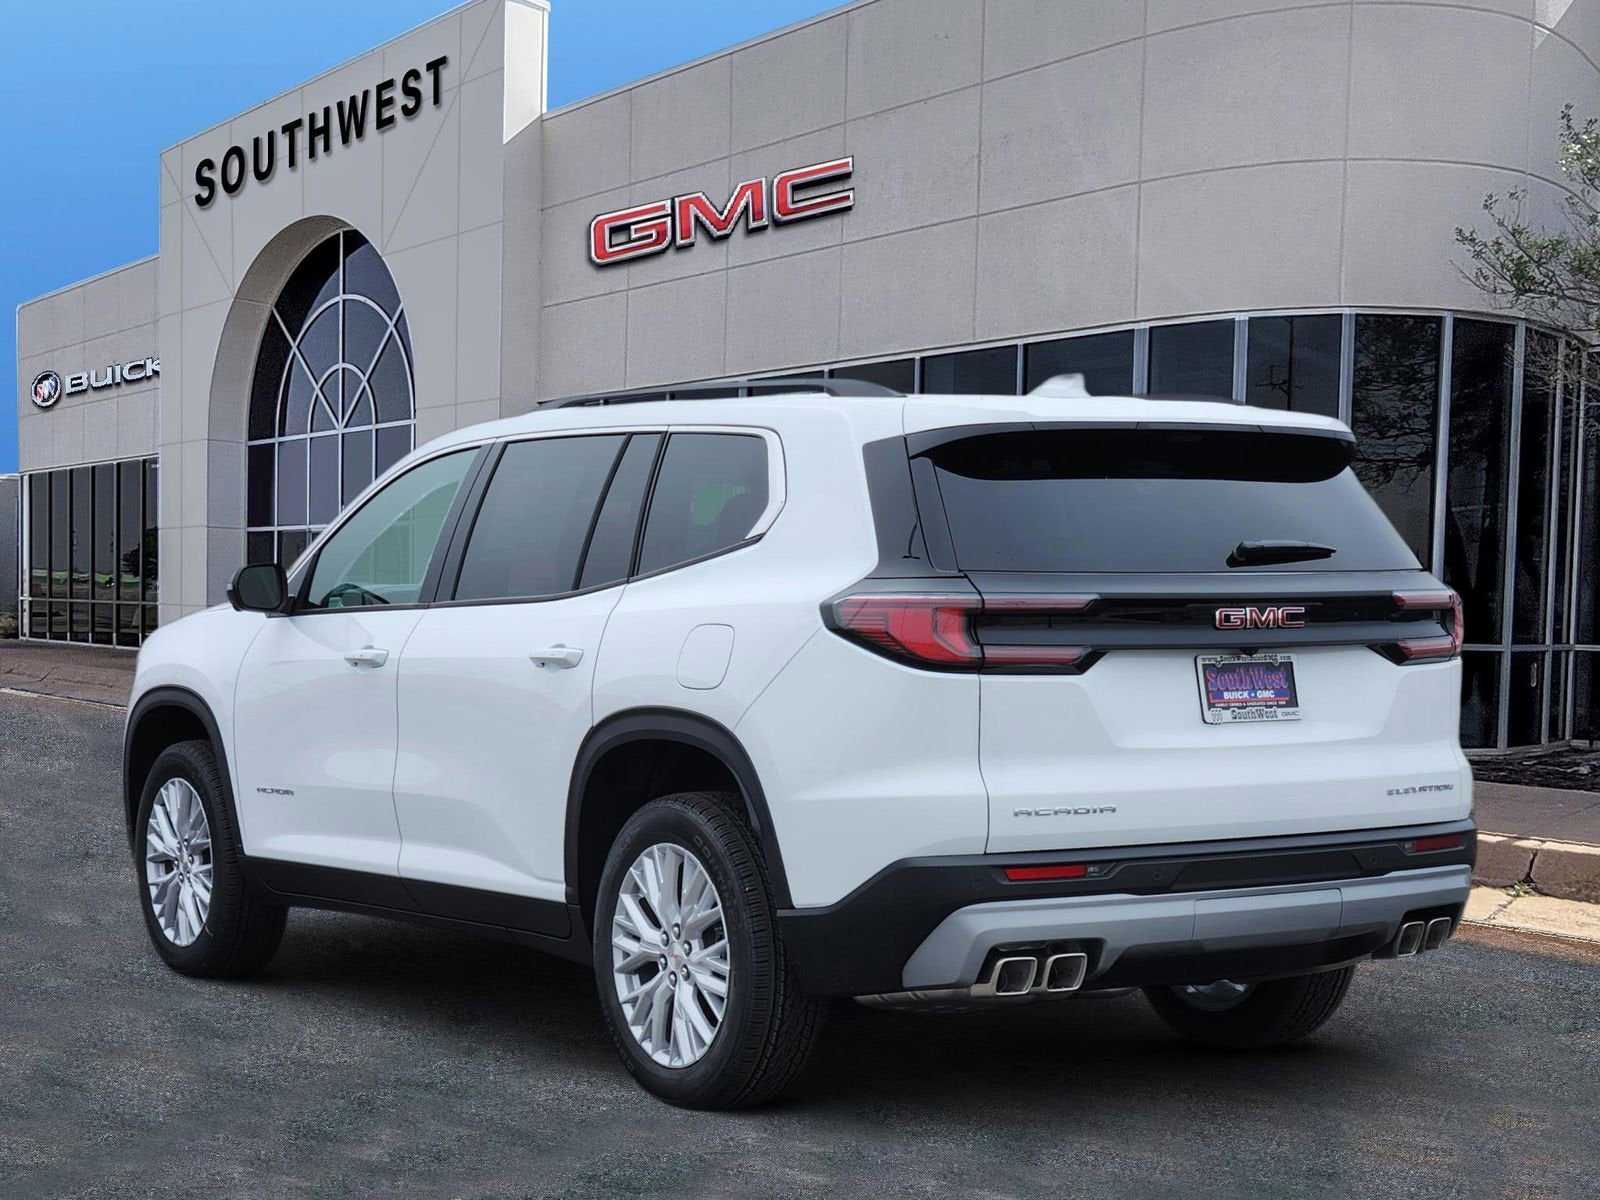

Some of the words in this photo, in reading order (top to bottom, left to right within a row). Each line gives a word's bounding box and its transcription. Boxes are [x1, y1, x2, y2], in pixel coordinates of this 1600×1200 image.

[195, 55, 447, 207] SOUTHWEST
[588, 155, 855, 266] GMC
[65, 358, 160, 395] BUICK
[1215, 606, 1305, 629] GMC
[1223, 690, 1249, 700] BUICK
[1256, 690, 1275, 699] GMC
[1231, 708, 1278, 720] SouthWest
[256, 787, 295, 796] ACADIA
[1386, 783, 1455, 796] ELEVATION
[1013, 806, 1117, 817] ACADIA
